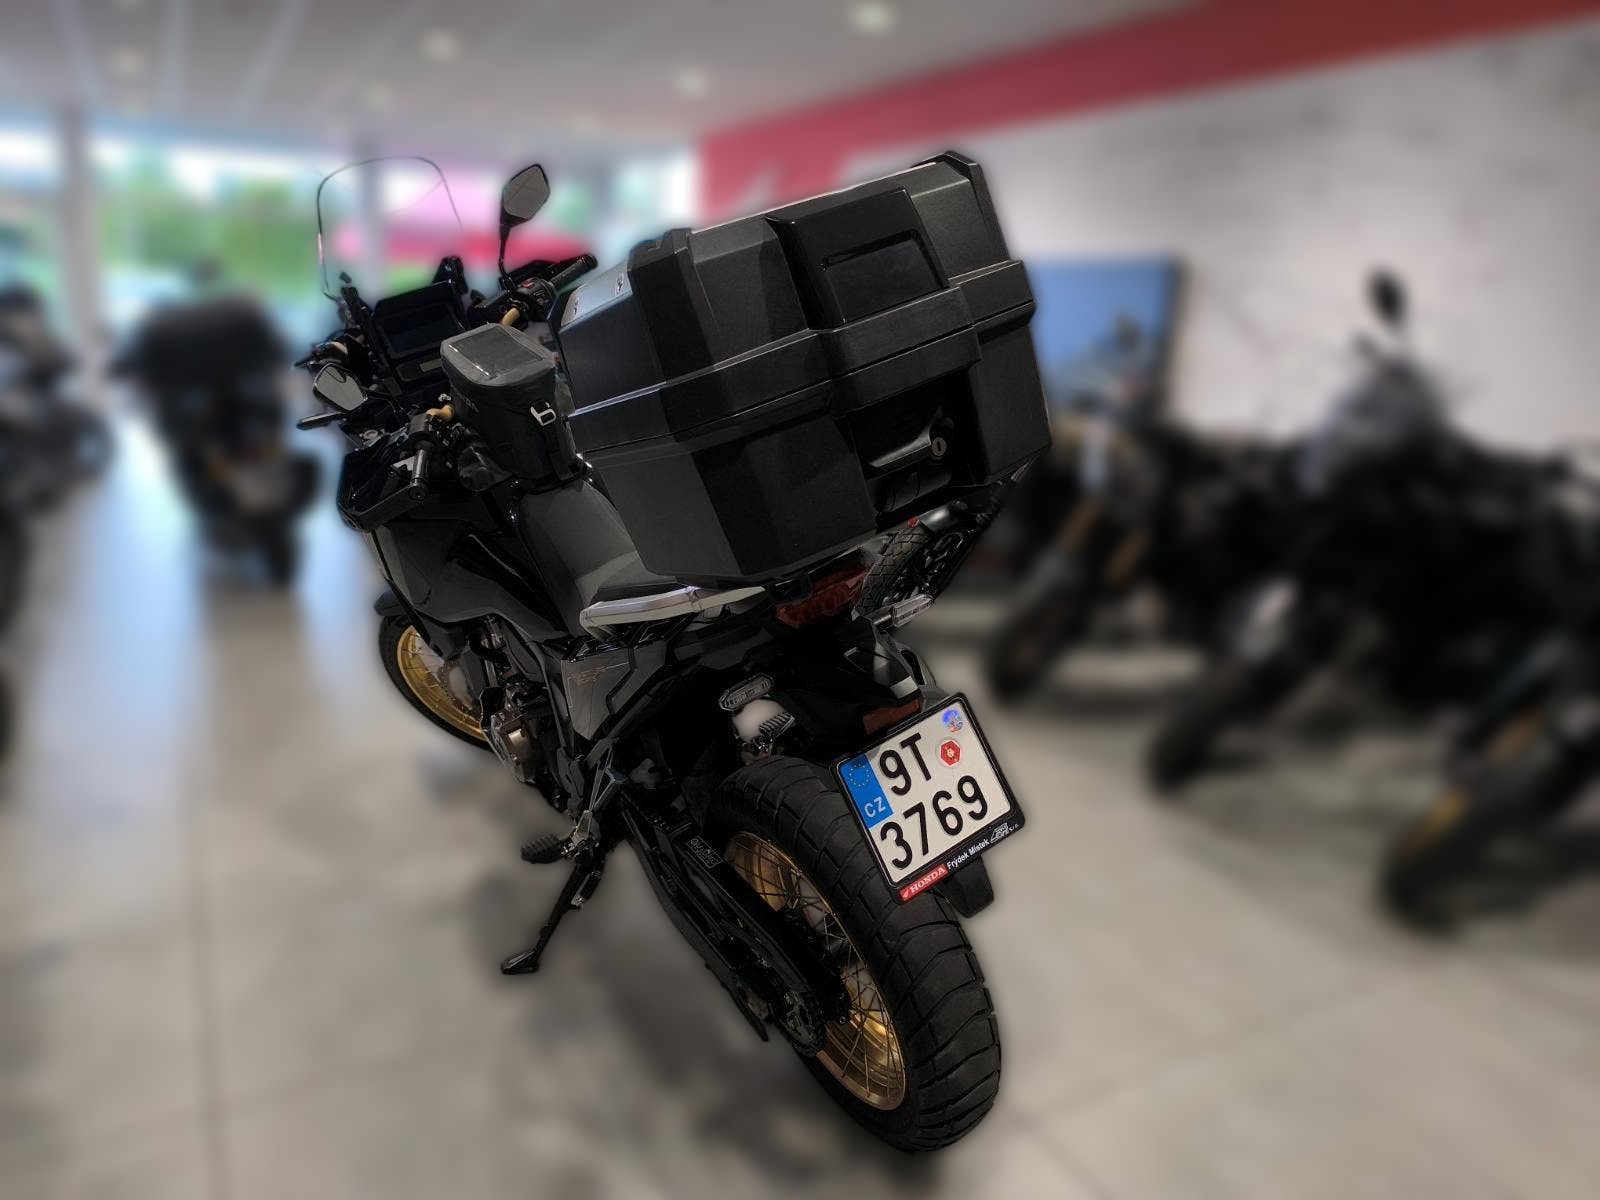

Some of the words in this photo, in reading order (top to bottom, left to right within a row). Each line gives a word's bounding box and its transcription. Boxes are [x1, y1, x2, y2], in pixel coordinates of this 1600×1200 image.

[879, 732, 932, 796] 9T
[864, 796, 886, 818] CZ
[880, 775, 988, 870] 3769
[909, 866, 946, 894] HONDA
